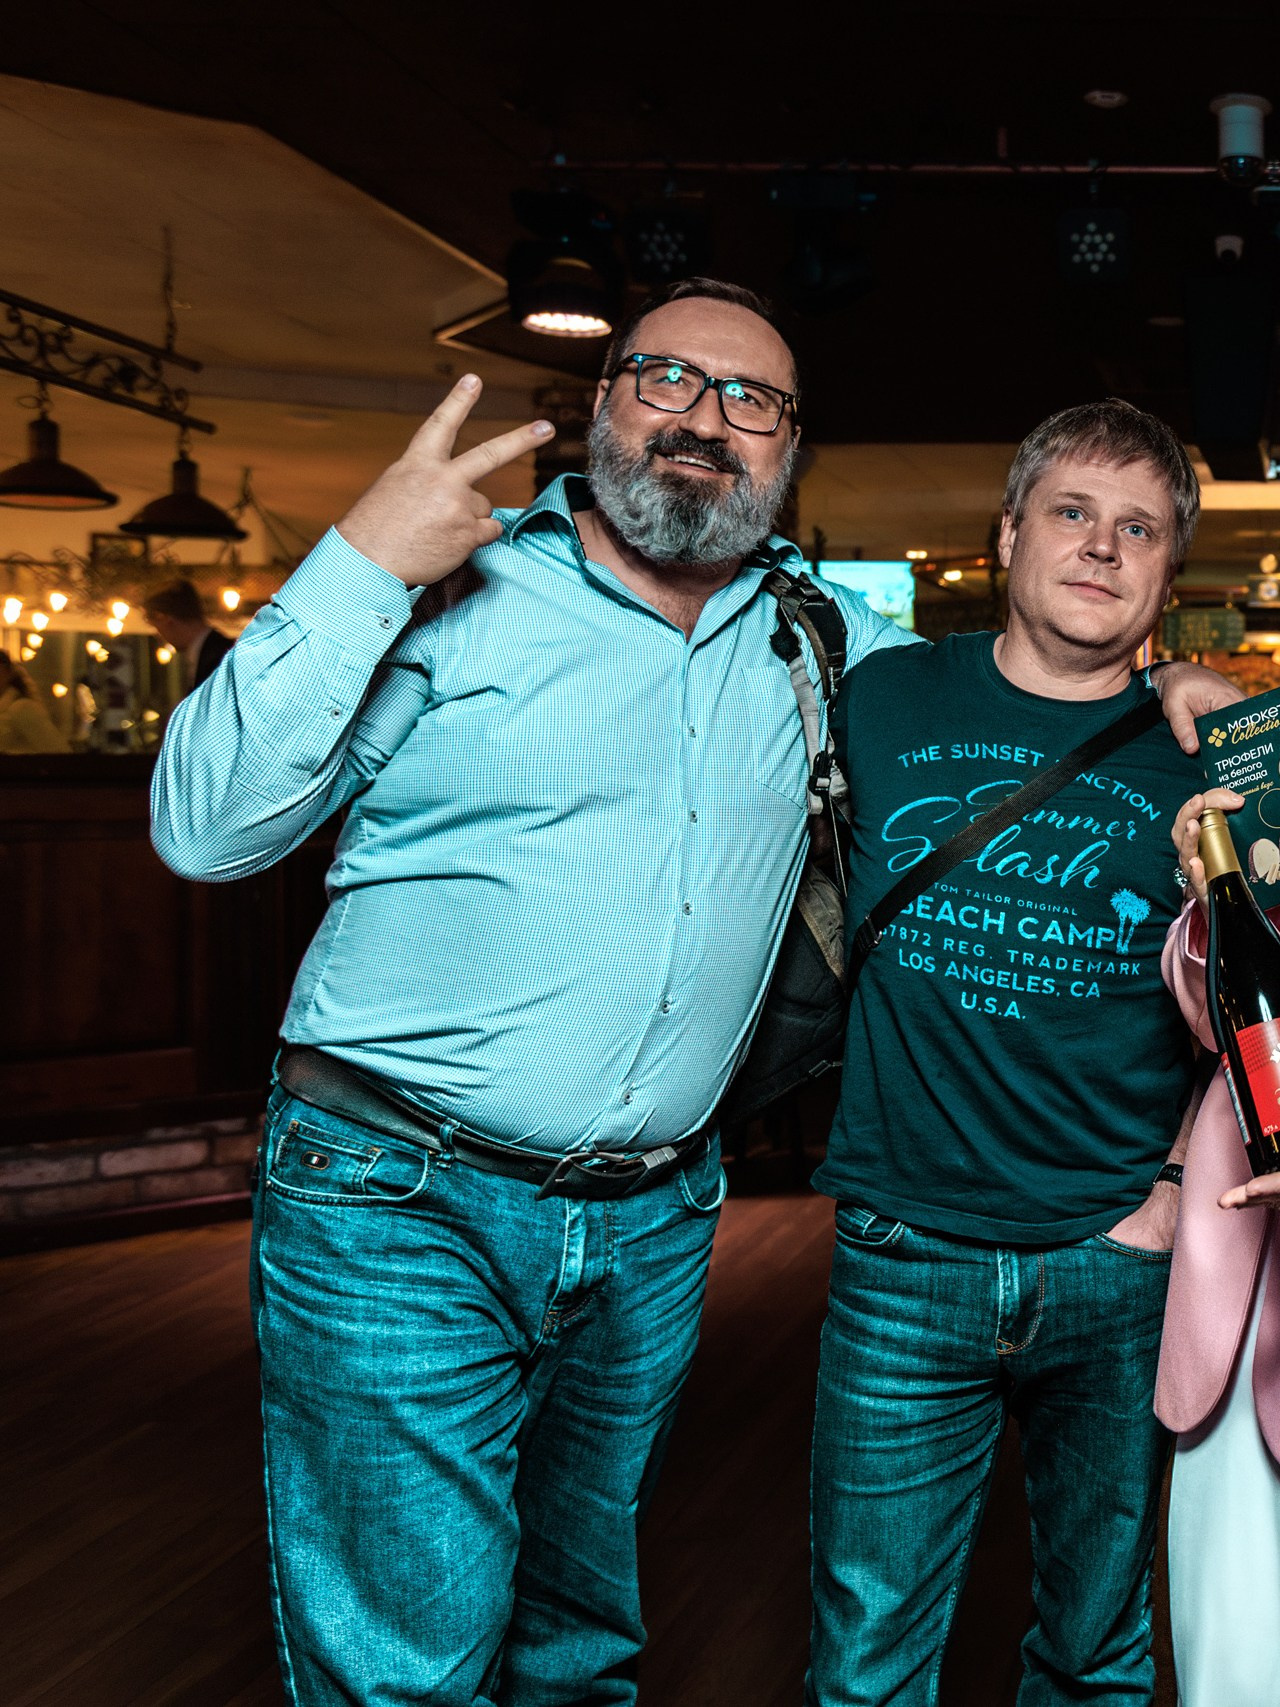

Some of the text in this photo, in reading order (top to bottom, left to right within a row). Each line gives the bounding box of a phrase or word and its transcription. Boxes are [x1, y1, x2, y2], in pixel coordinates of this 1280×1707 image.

[1214, 742, 1274, 772] ТРЮФЕЛИ
[1218, 761, 1263, 783] из белого
[898, 743, 1162, 822] THE SUNSET NCTION
[966, 779, 1138, 842] Smmer
[881, 796, 1110, 888] Slash
[934, 882, 1078, 916] TOM TAILOR ORIGINAL
[1017, 917, 1116, 950] CAMP
[899, 948, 1100, 998] LOS ANGELES, CA
[943, 937, 993, 960] REG.
[1006, 950, 1141, 976] TRADEMARK
[960, 991, 1026, 1020] U.S.A.
